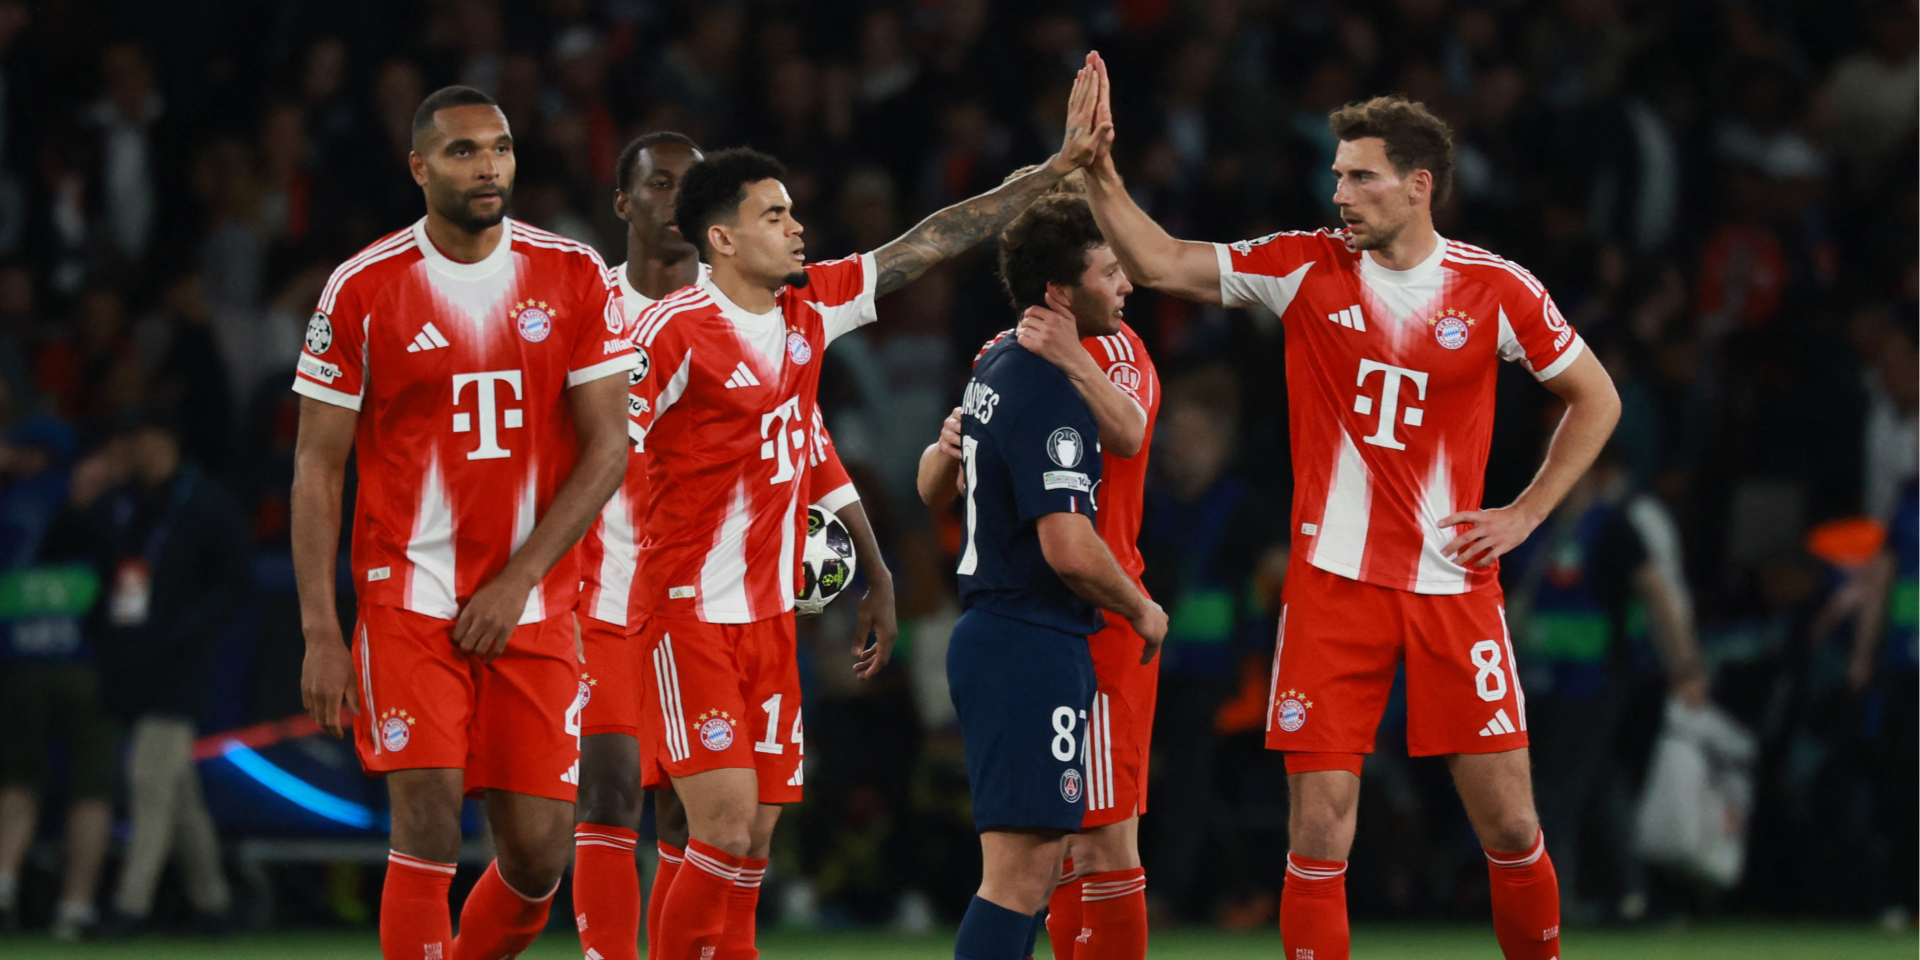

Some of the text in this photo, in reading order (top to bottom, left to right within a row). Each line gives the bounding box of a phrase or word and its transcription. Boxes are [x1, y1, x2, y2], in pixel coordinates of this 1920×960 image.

[1443, 319, 1465, 332] BAYERN
[453, 370, 523, 460] T
[1470, 640, 1507, 702] 8
[708, 719, 731, 732] BAYERN
[754, 694, 803, 755] 14
